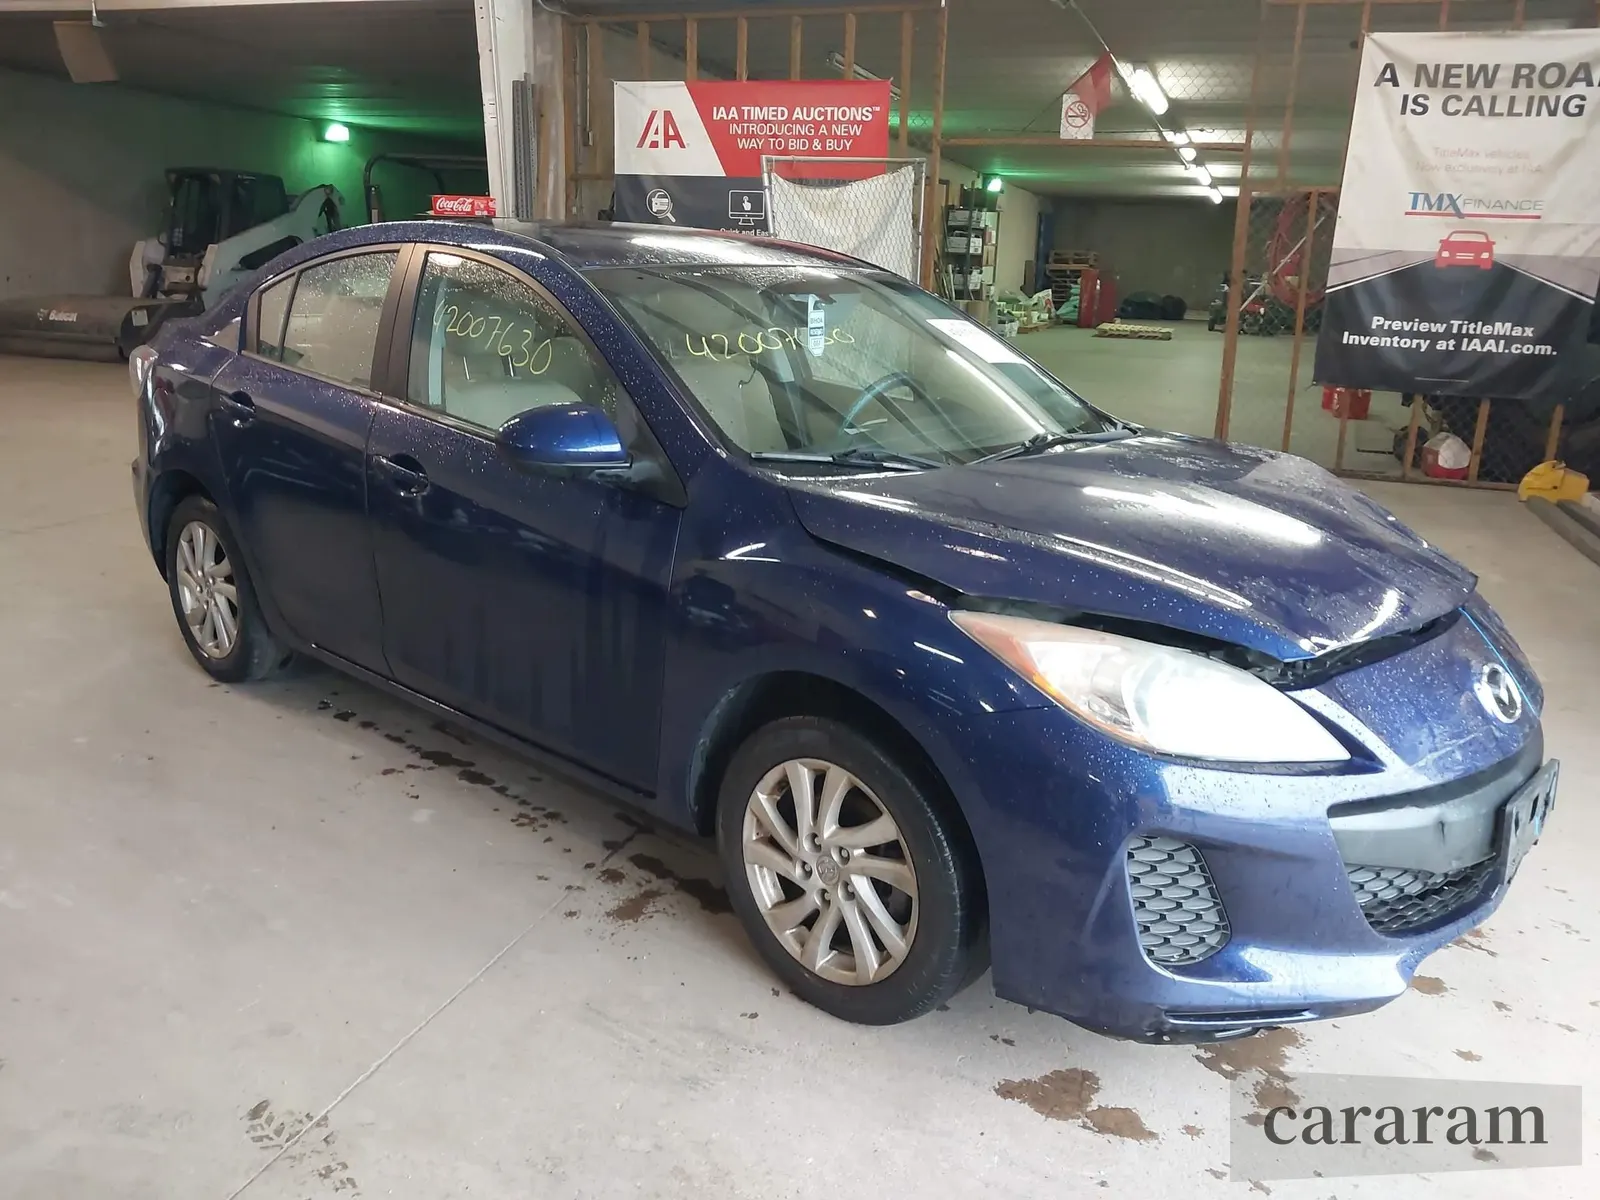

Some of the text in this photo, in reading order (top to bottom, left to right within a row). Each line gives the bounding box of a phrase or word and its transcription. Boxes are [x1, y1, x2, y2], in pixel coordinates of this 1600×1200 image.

[1374, 62, 1600, 89] A NEW ROA
[713, 106, 739, 120] IAA
[741, 106, 788, 121] TIMED
[1400, 93, 1587, 117] IS CALLING
[729, 123, 862, 136] INTRODUCING A NEW
[737, 137, 853, 151] WAY TO BID & BUY
[433, 298, 552, 374] 42007630
[1371, 316, 1534, 337] Preview TitleMax
[1342, 331, 1558, 355] Inventory at IAAI.com.
